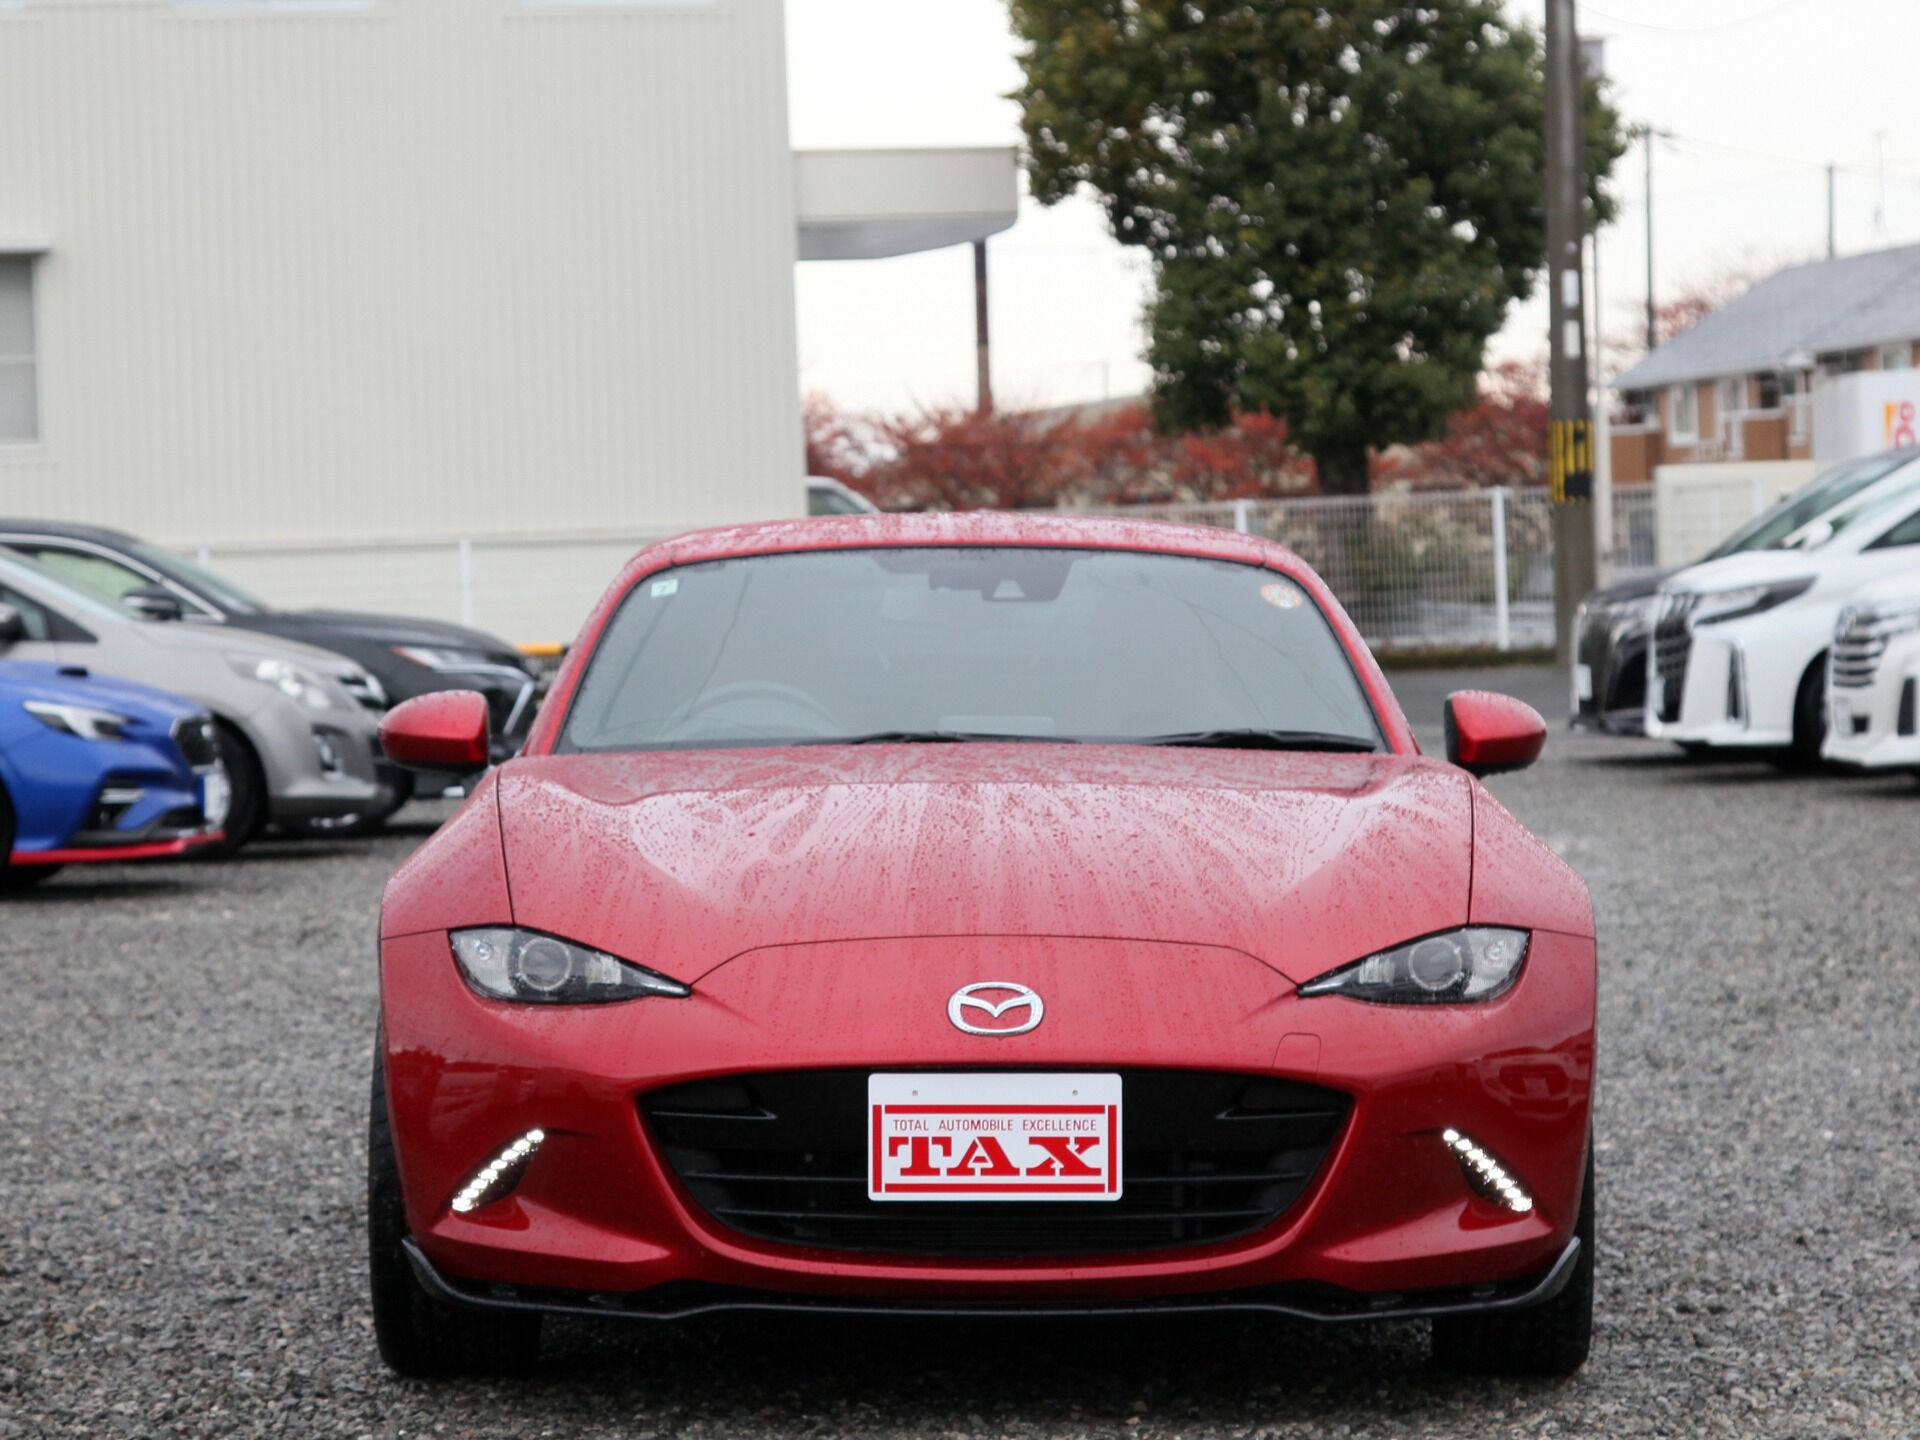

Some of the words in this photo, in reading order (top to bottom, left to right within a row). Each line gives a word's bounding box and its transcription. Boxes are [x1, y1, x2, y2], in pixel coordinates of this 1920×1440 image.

[893, 1119, 929, 1132] TOTAL
[938, 1119, 1014, 1132] AUTOMOBILE
[1022, 1119, 1097, 1132] EXCELLENCE
[888, 1136, 1102, 1177] TAX
